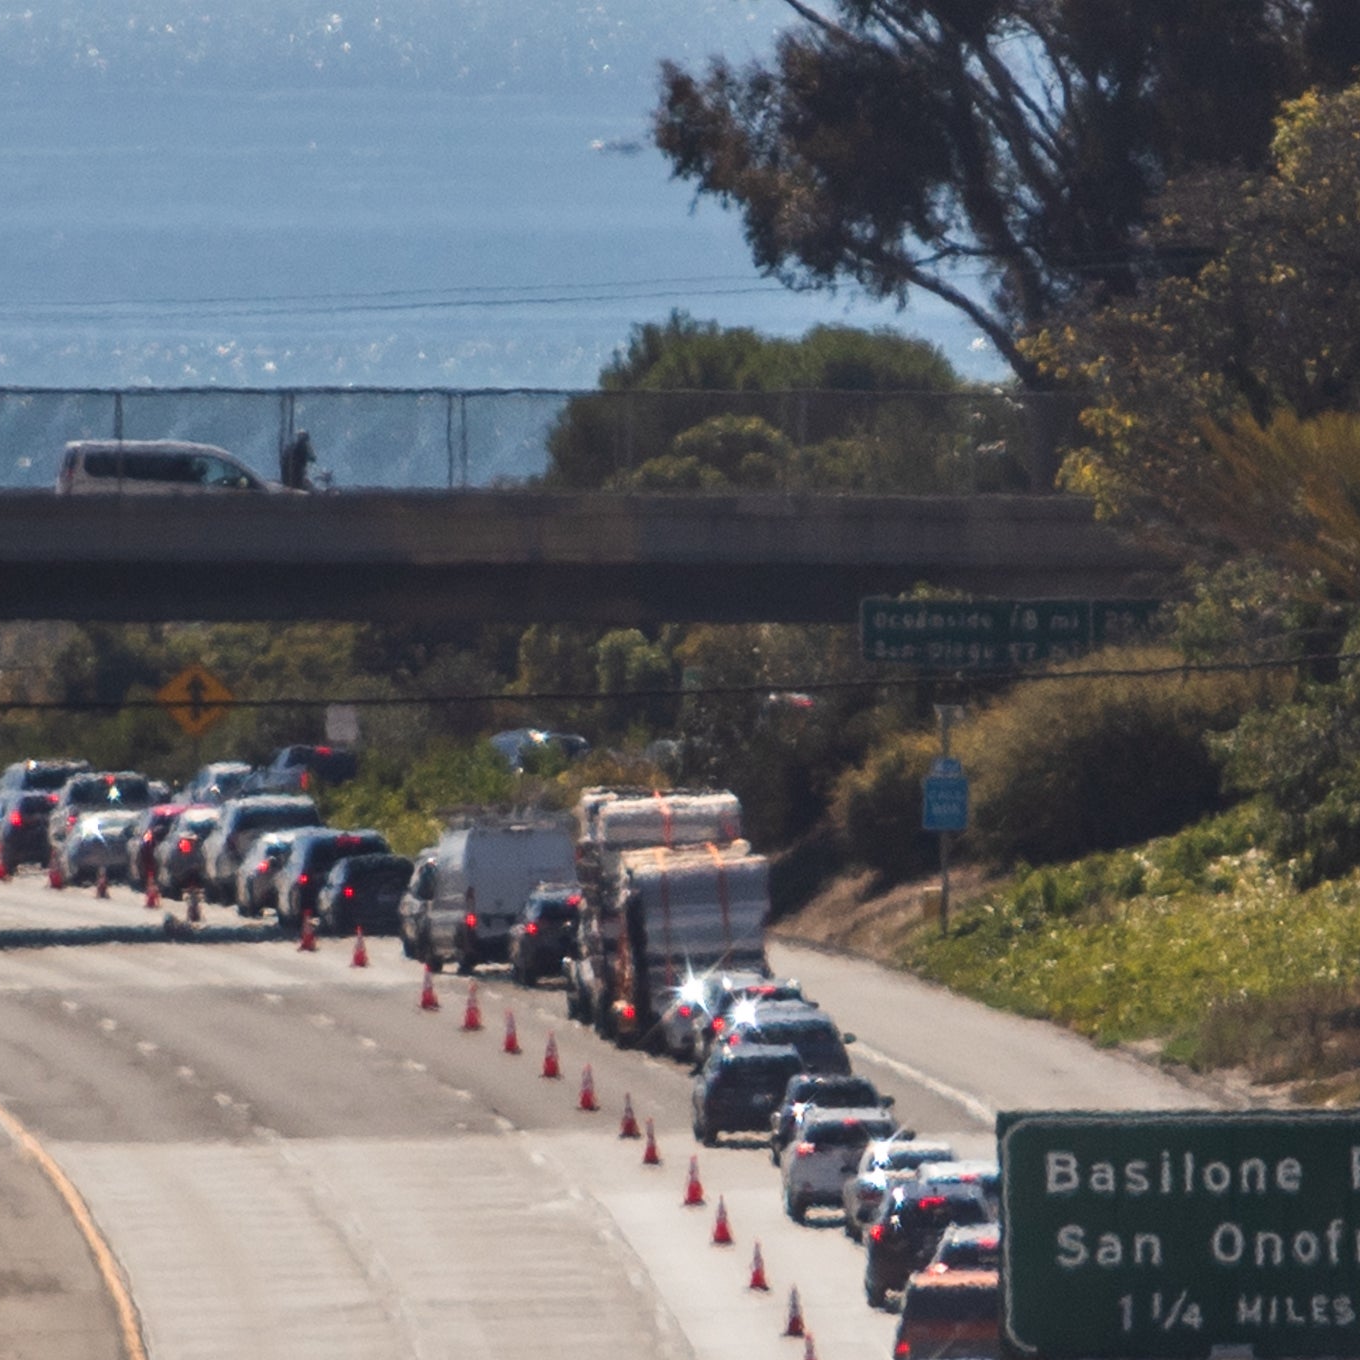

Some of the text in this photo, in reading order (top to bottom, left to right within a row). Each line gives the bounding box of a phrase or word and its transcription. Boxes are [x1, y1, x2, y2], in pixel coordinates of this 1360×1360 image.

[1046, 1150, 1303, 1194] Basilone
[1056, 1224, 1162, 1268] San
[1238, 1293, 1357, 1327] MILES
